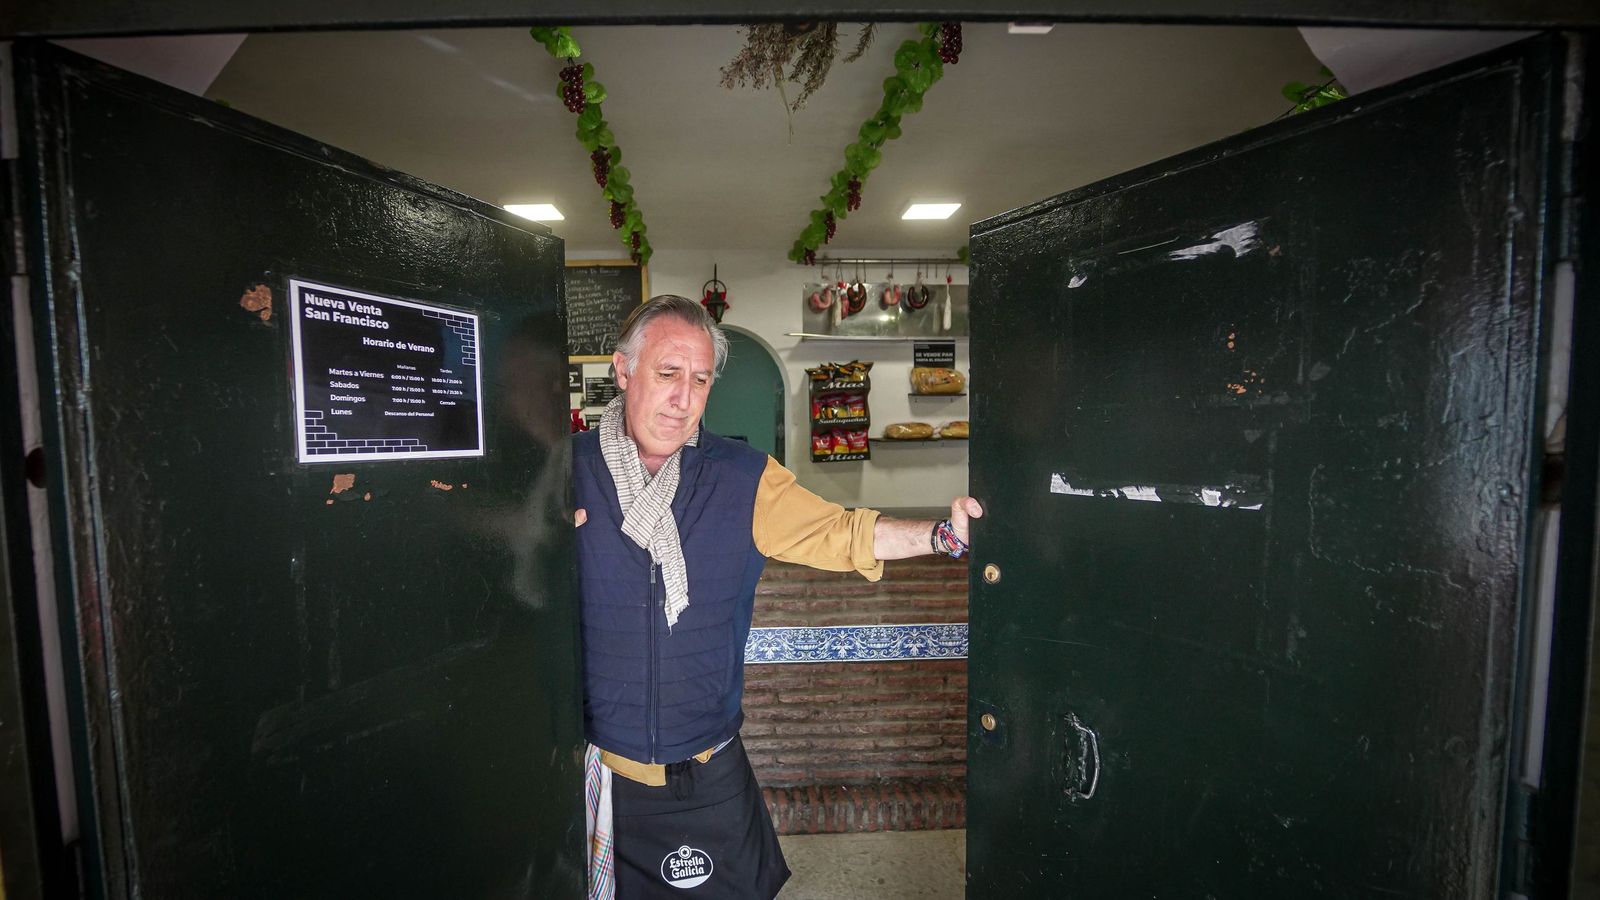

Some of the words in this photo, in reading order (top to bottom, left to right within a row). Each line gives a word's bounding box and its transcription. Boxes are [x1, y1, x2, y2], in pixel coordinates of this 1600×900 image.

[304, 292, 346, 311] Nueva
[348, 300, 383, 317] Venta
[304, 307, 331, 322] San
[333, 311, 390, 330] Francisco
[363, 336, 395, 349] Horario
[396, 340, 407, 350] de
[407, 342, 435, 353] Verano
[329, 367, 353, 376] Martes
[359, 370, 384, 379] Viernes
[330, 381, 360, 389] Sabados
[330, 394, 367, 404] Domingos
[669, 856, 705, 869] Estrella
[671, 865, 705, 879] Galicia
